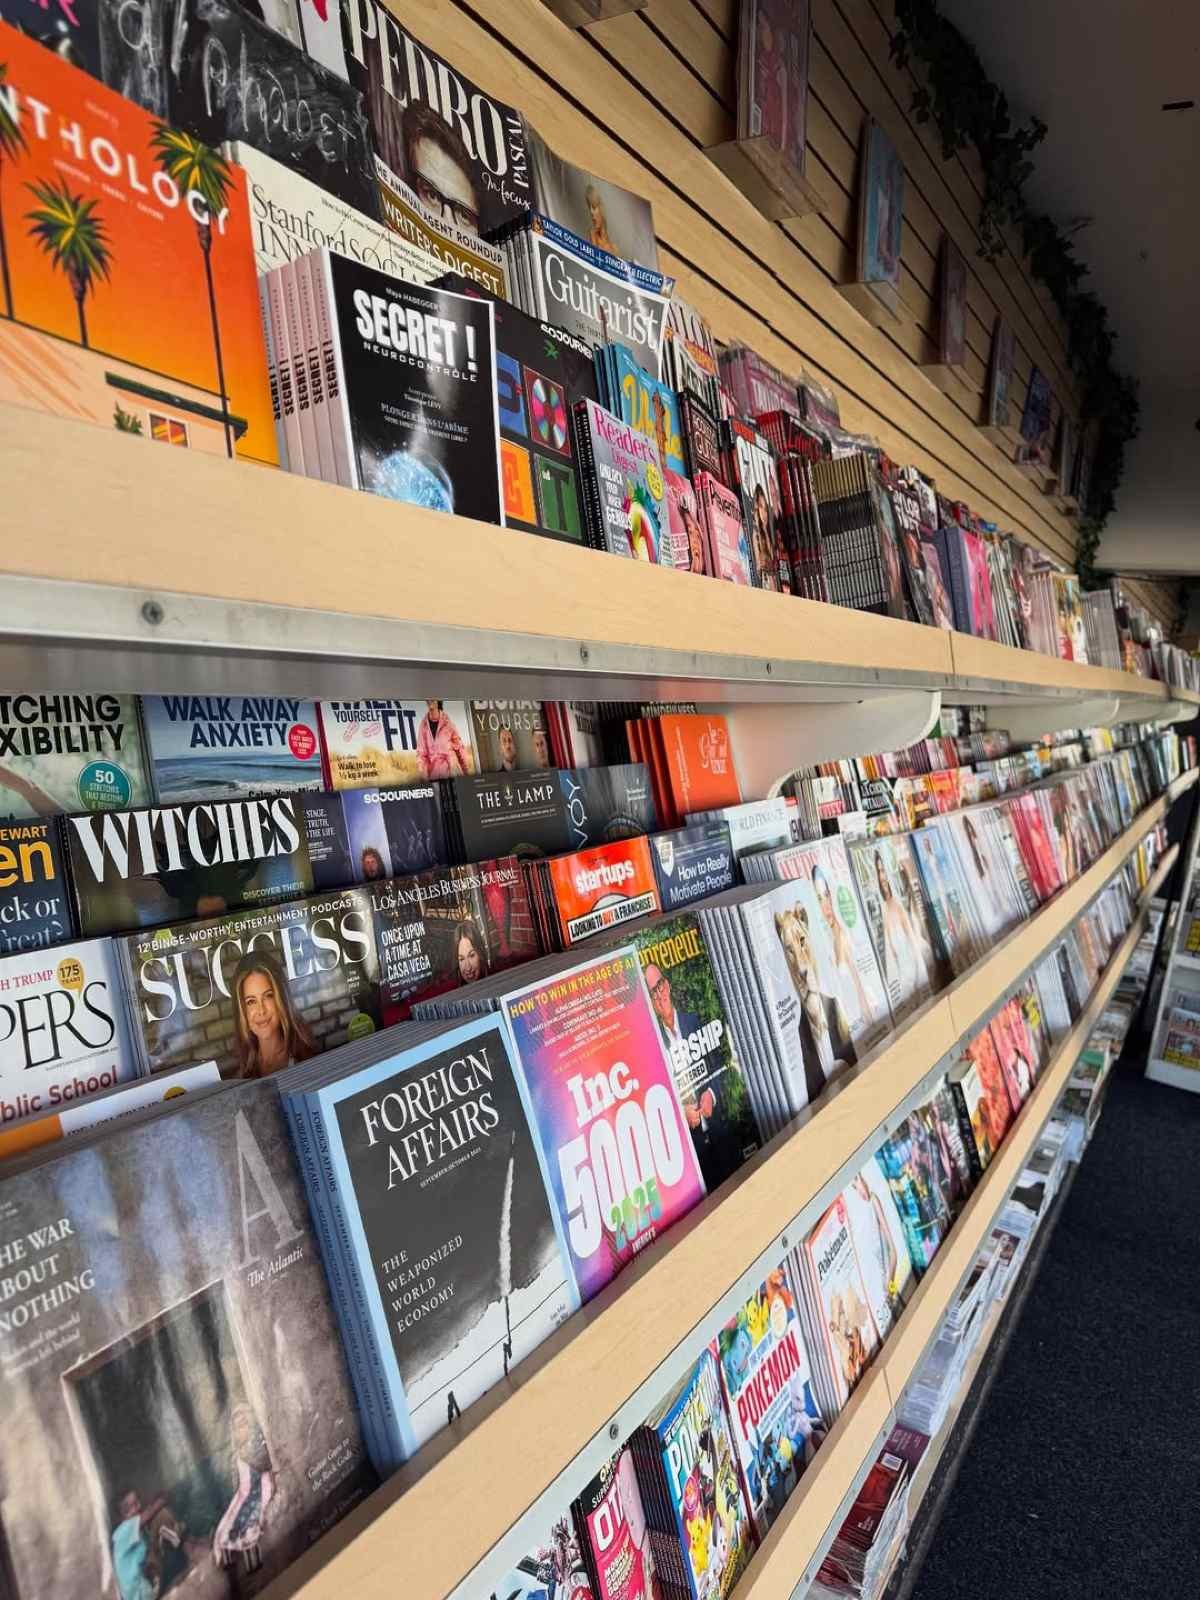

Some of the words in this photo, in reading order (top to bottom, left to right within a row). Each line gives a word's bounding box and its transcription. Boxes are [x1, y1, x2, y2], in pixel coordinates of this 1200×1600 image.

[349, 0, 508, 177] PEDRO
[506, 117, 530, 188] PASCAL
[252, 183, 347, 255] Stanford
[423, 212, 452, 237] AGENT
[456, 232, 503, 263] ROUNDUP
[445, 250, 500, 296] DIGEST
[636, 268, 663, 287] ELECTRIC
[544, 252, 659, 354] Guitarist
[352, 288, 457, 366] SECRET
[464, 325, 478, 372] !
[309, 356, 324, 405] SECRET
[323, 349, 339, 399] SECRET
[363, 341, 478, 382] NEUROCONTRÔLE
[279, 367, 294, 416] SECRET
[294, 362, 310, 410] SECRET
[162, 695, 235, 722] WALK
[240, 696, 301, 722] AWAY
[334, 709, 382, 723] YOURSELF
[380, 709, 418, 751] FIT
[0, 724, 124, 757] XIBILITY
[190, 722, 288, 748] ANXIETY
[95, 769, 115, 784] 50
[363, 788, 434, 804] SOJOURNERS
[476, 792, 502, 810] THE
[517, 785, 554, 803] LAMP
[69, 797, 300, 884] WITCHES
[0, 840, 55, 888] en
[574, 859, 636, 897] startups
[677, 865, 698, 882] How
[697, 861, 707, 874] to
[706, 853, 730, 871] Really
[34, 897, 60, 919] or
[371, 893, 396, 912] LOS
[397, 883, 442, 906] ANGELES
[439, 873, 482, 896] BUSINESS
[479, 866, 519, 886] JOURNAL
[669, 877, 707, 904] Motivate
[705, 870, 732, 890] People
[151, 924, 233, 952] BINGE-WORTHY
[234, 907, 309, 933] ENTERTAINMENT
[310, 897, 365, 916] PODCASTS
[381, 925, 405, 946] ONCE
[404, 920, 427, 940] UPON
[58, 963, 81, 979] 175
[386, 961, 411, 981] CASA
[409, 955, 432, 973] VEGA
[391, 941, 412, 961] TIME
[411, 938, 423, 956] AT
[12, 969, 54, 989] TRUMP
[509, 1001, 536, 1019] HOW
[534, 994, 549, 1008] TO
[548, 986, 569, 1002] WIN
[567, 982, 580, 995] IN
[578, 974, 596, 990] THE
[594, 965, 613, 982] AGE
[611, 960, 625, 977] OF
[48, 1065, 119, 1106] School
[359, 1047, 495, 1149] FOREIGN
[566, 1061, 640, 1129] Inc.
[312, 1111, 331, 1154] FOREIGN
[386, 1091, 500, 1191] AFFAIRS
[232, 1108, 305, 1273] A
[320, 1154, 339, 1193] AFFAIRS
[557, 1083, 685, 1259] 5000
[28, 1216, 76, 1251] WAR
[610, 1176, 662, 1254] 2025
[247, 1269, 266, 1289] The
[266, 1245, 304, 1279] Atlantic
[381, 1249, 410, 1276] THE
[386, 1234, 464, 1295] WEAPONIZED
[0, 1269, 97, 1335] NOTHING
[391, 1276, 437, 1313] WORLD
[396, 1283, 457, 1335] ECONOMY
